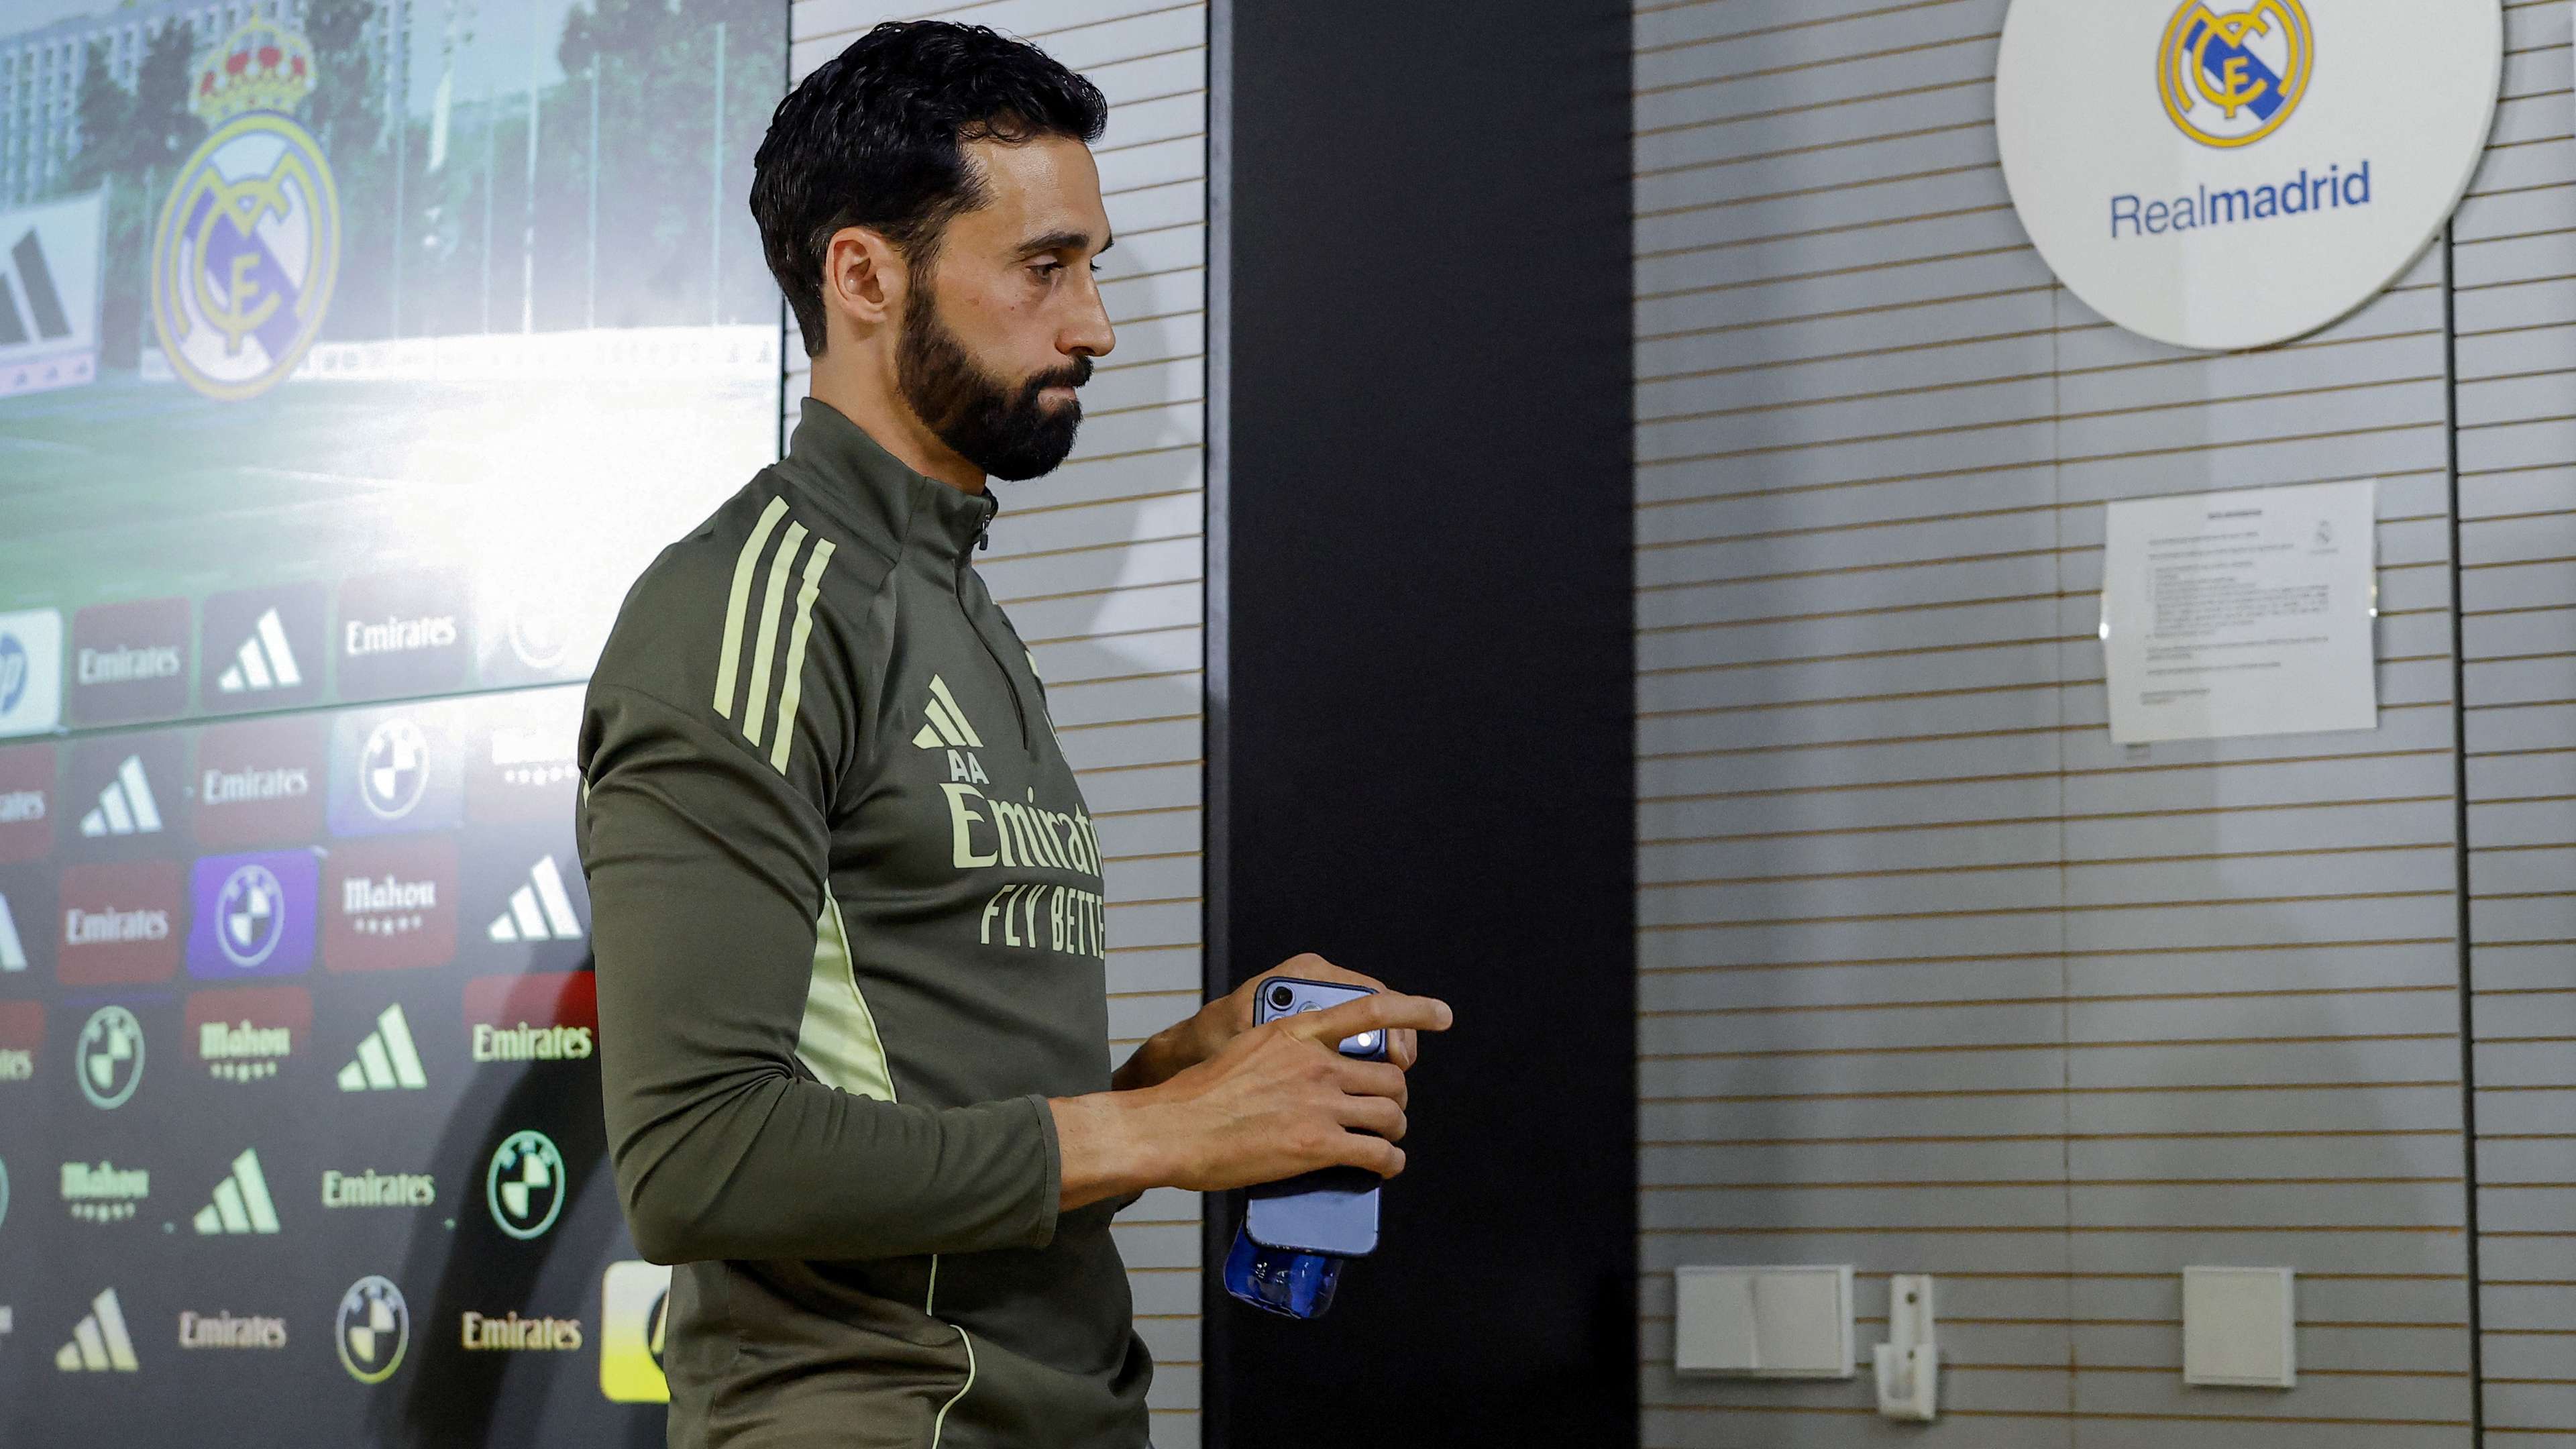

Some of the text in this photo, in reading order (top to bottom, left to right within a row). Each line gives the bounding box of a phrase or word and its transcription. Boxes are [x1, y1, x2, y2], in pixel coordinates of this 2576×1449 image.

[346, 615, 457, 657] Emirates
[78, 645, 182, 686] Emirates
[203, 765, 309, 806] Emirates
[946, 749, 990, 785] AA
[343, 872, 437, 914] Mahou
[980, 883, 1050, 949] FLY
[472, 1020, 594, 1063] Emirates
[321, 1169, 436, 1208] Emirates
[461, 1311, 583, 1351] Emirates
